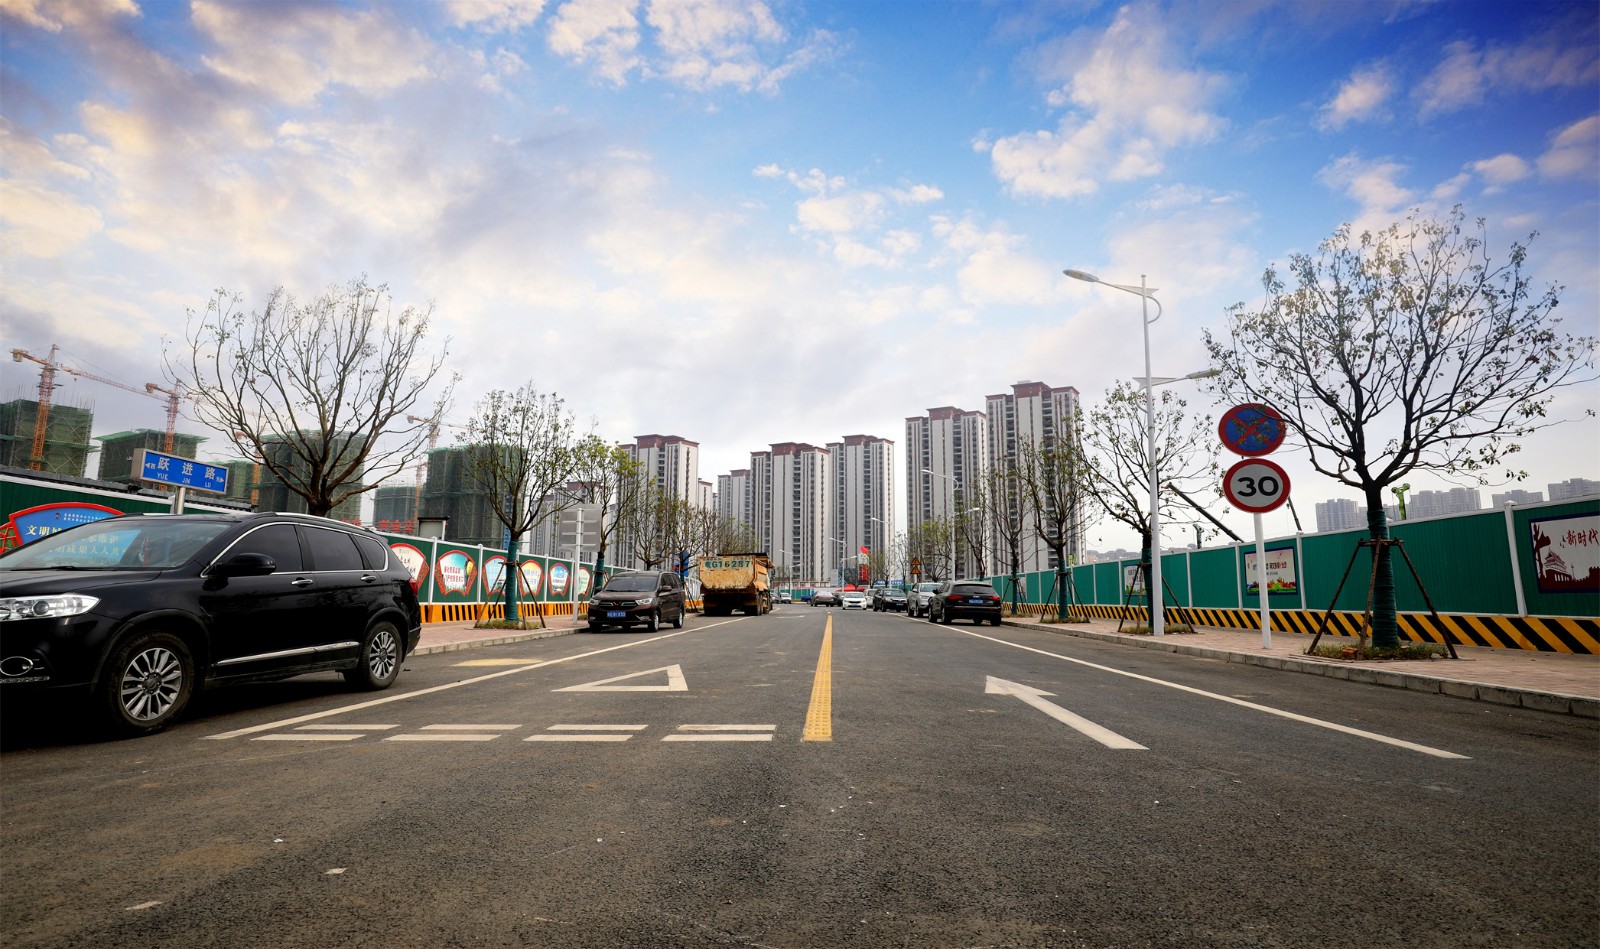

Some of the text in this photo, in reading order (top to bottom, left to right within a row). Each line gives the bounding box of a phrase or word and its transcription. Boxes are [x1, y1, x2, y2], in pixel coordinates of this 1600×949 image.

[157, 457, 215, 480] 跃进路
[157, 472, 168, 480] YUE
[182, 477, 190, 485] JIN
[1237, 476, 1279, 497] 30
[1567, 527, 1600, 548] 新时代
